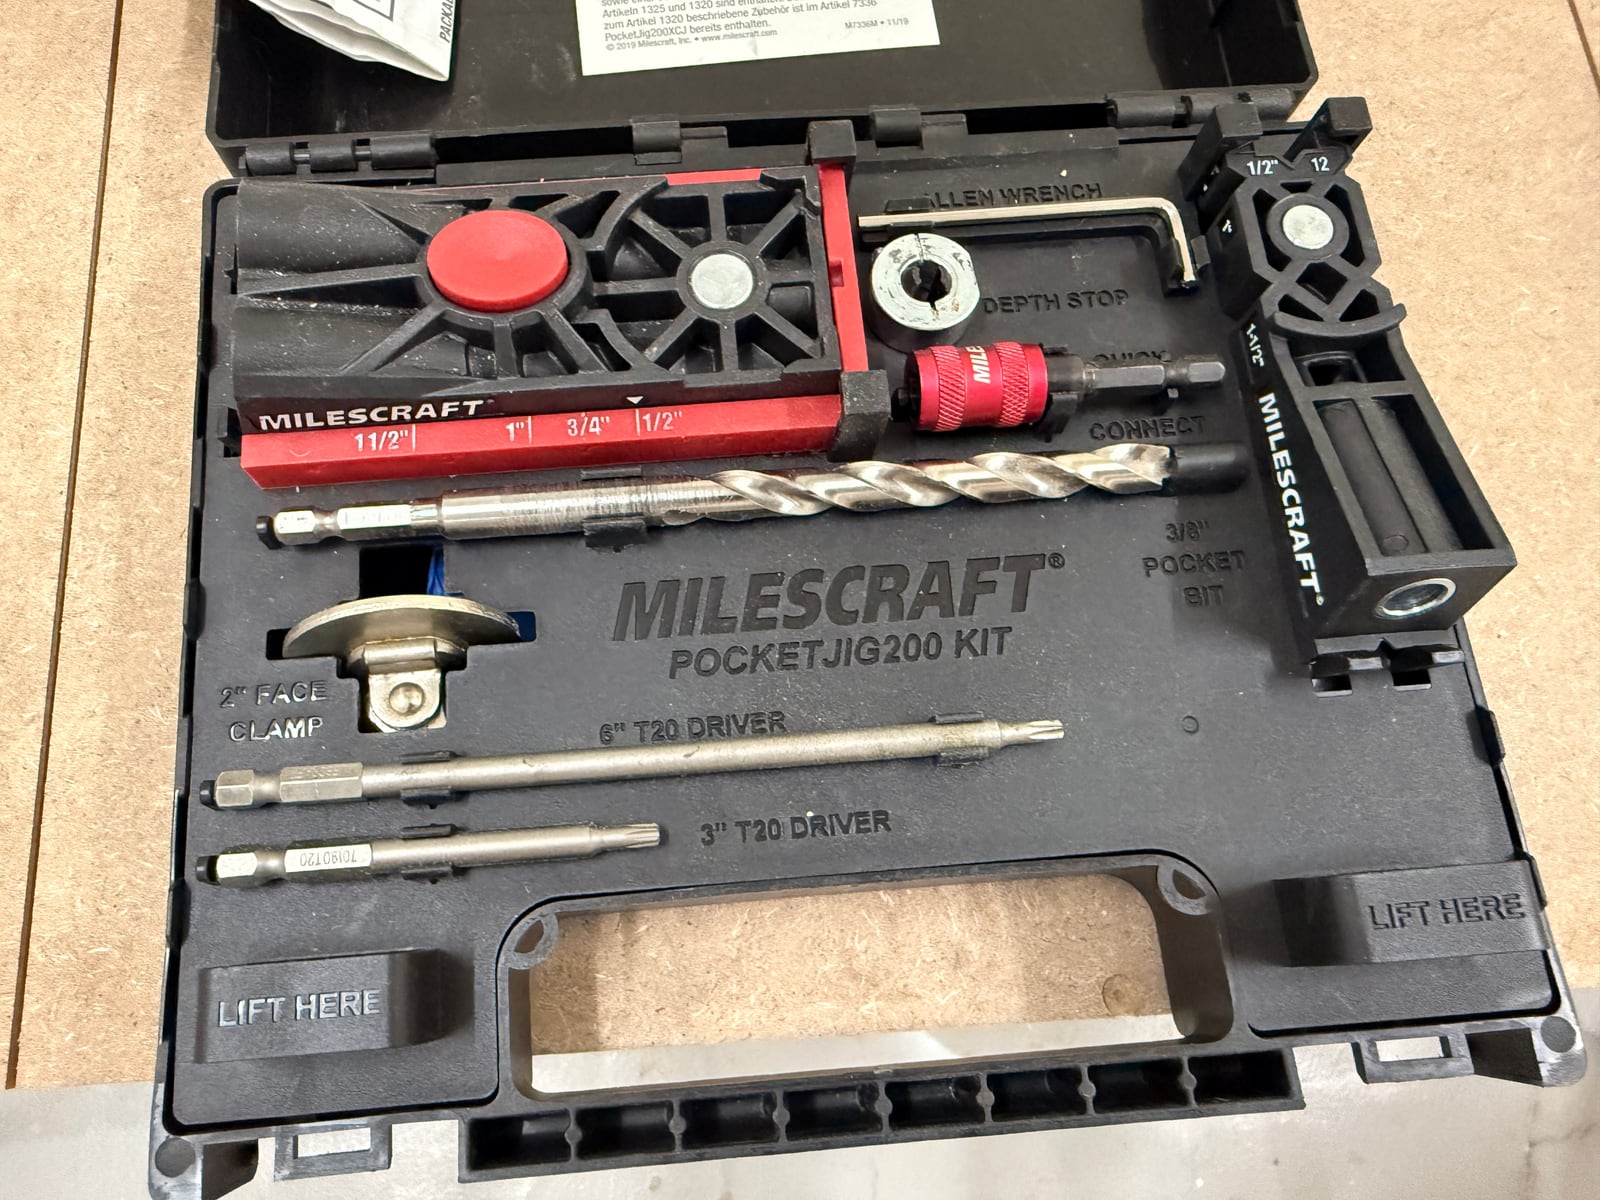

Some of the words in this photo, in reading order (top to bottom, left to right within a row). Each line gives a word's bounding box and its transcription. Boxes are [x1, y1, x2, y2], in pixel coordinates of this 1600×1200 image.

[602, 7, 638, 18] Artikeln
[641, 4, 665, 14] 1325
[668, 2, 686, 12] und
[689, 0, 712, 10] 1320
[603, 20, 624, 30] zum
[626, 17, 656, 28] Artikel
[659, 14, 684, 24] 1320
[686, 9, 749, 22] beschriebene
[751, 5, 789, 17] Zubehör
[792, 4, 804, 12] ist
[806, 3, 818, 11] im
[820, 1, 850, 10] Artikel
[689, 23, 722, 34] bereits
[724, 20, 772, 31] enthalten.
[616, 41, 636, 50] 2019
[1246, 159, 1279, 176] 1/2"
[1311, 156, 1330, 173] 12
[1000, 182, 1103, 205] WRENCH
[983, 294, 1061, 315] DEPTH
[1067, 289, 1130, 311] STOP
[567, 416, 611, 437] 3/4"
[642, 411, 683, 432] 1/2"
[1089, 416, 1205, 441] CONNECT
[1142, 550, 1246, 577] POCKET
[1184, 585, 1224, 606] BIT
[669, 632, 942, 680] POCKETJIG200
[954, 626, 1013, 659] KIT
[219, 686, 247, 708] 2"
[256, 680, 327, 705] FACE
[229, 716, 323, 742] CLAMP
[599, 722, 625, 745] 6"
[634, 719, 680, 743] T20
[688, 711, 787, 738] DRIVER
[700, 822, 727, 845] 3"
[735, 817, 782, 844] T20
[791, 810, 892, 840] DRIVER
[1368, 900, 1430, 931] LIFT
[1438, 893, 1525, 924] HERE
[218, 997, 286, 1027] LIFT
[294, 988, 381, 1021] HERE
